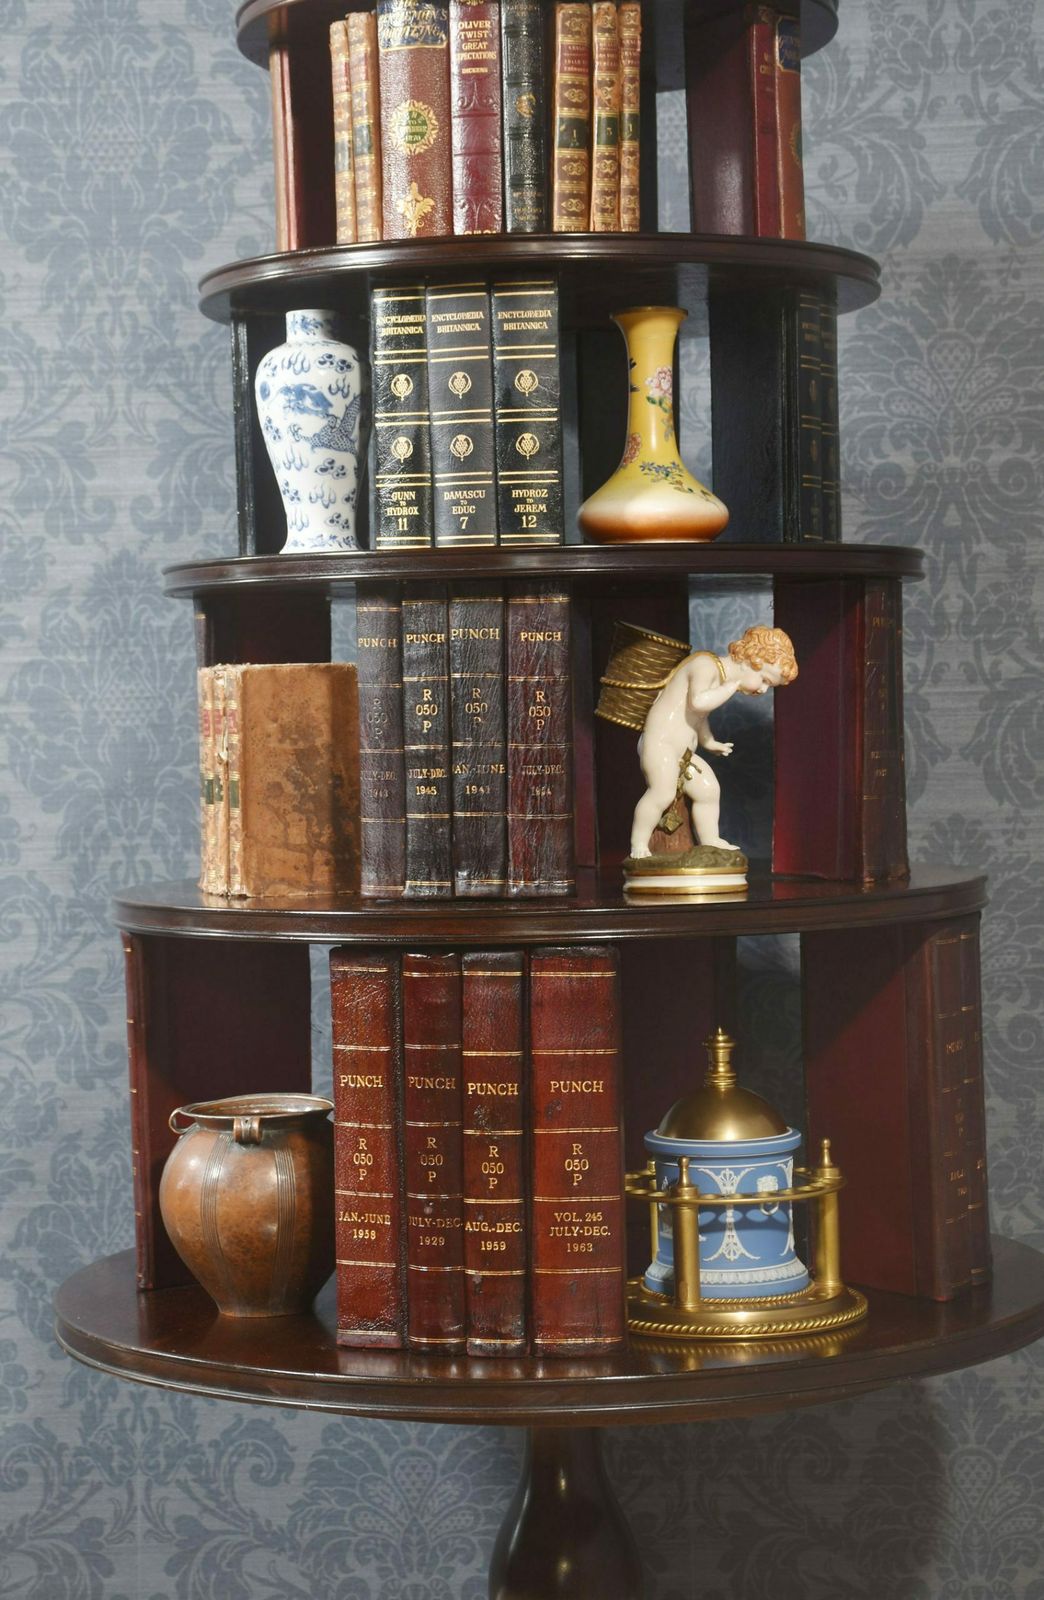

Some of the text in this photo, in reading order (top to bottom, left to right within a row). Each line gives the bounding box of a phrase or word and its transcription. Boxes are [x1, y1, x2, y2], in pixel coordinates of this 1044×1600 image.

[459, 20, 491, 29] OLIVER
[460, 30, 489, 39] TWIST
[462, 42, 488, 50] GREAT
[437, 323, 481, 333] BRITANNICA
[504, 321, 548, 331] BRITANNICA
[392, 491, 416, 501] GUNN
[444, 490, 486, 500] DAMASCU
[512, 489, 549, 498] HYDROZ
[387, 506, 419, 516] HYDROX
[452, 506, 476, 515] EDUC
[514, 504, 547, 513] JEREM
[397, 517, 408, 531] 11
[460, 516, 468, 529] 7
[522, 515, 537, 528] 12
[406, 634, 445, 644] PUNCH
[451, 629, 500, 639] PUNCH
[520, 632, 562, 642] PUNCH
[358, 638, 397, 648] PUNCH
[423, 689, 432, 701] R
[473, 688, 481, 698] R
[536, 691, 546, 702] R
[416, 704, 438, 715] 050
[465, 702, 488, 713] 050
[529, 706, 551, 717] 050
[423, 720, 432, 732] P
[537, 720, 544, 730] P
[416, 786, 437, 795] 1945
[340, 1075, 383, 1088] PUNCH
[408, 1076, 455, 1089] PUNCH
[550, 1081, 603, 1092] PUNCH
[467, 1083, 518, 1095] PUNCH
[359, 1138, 367, 1150] R
[427, 1137, 437, 1149] R
[489, 1146, 499, 1157] R
[572, 1143, 582, 1155] R
[353, 1152, 373, 1165] 050
[420, 1154, 443, 1166] 050
[481, 1162, 504, 1174] 050
[565, 1159, 589, 1171] 050
[359, 1169, 367, 1180] P
[428, 1171, 437, 1182] P
[573, 1173, 582, 1186] P
[489, 1177, 498, 1188] P
[554, 1212, 603, 1222] VOL. 245
[465, 1221, 523, 1233] AUG.-DEC.
[549, 1226, 611, 1237] JULY-DEC.
[353, 1228, 376, 1240] 1958
[420, 1236, 445, 1246] 1929
[481, 1241, 507, 1251] 1959
[567, 1243, 593, 1252] 1963
